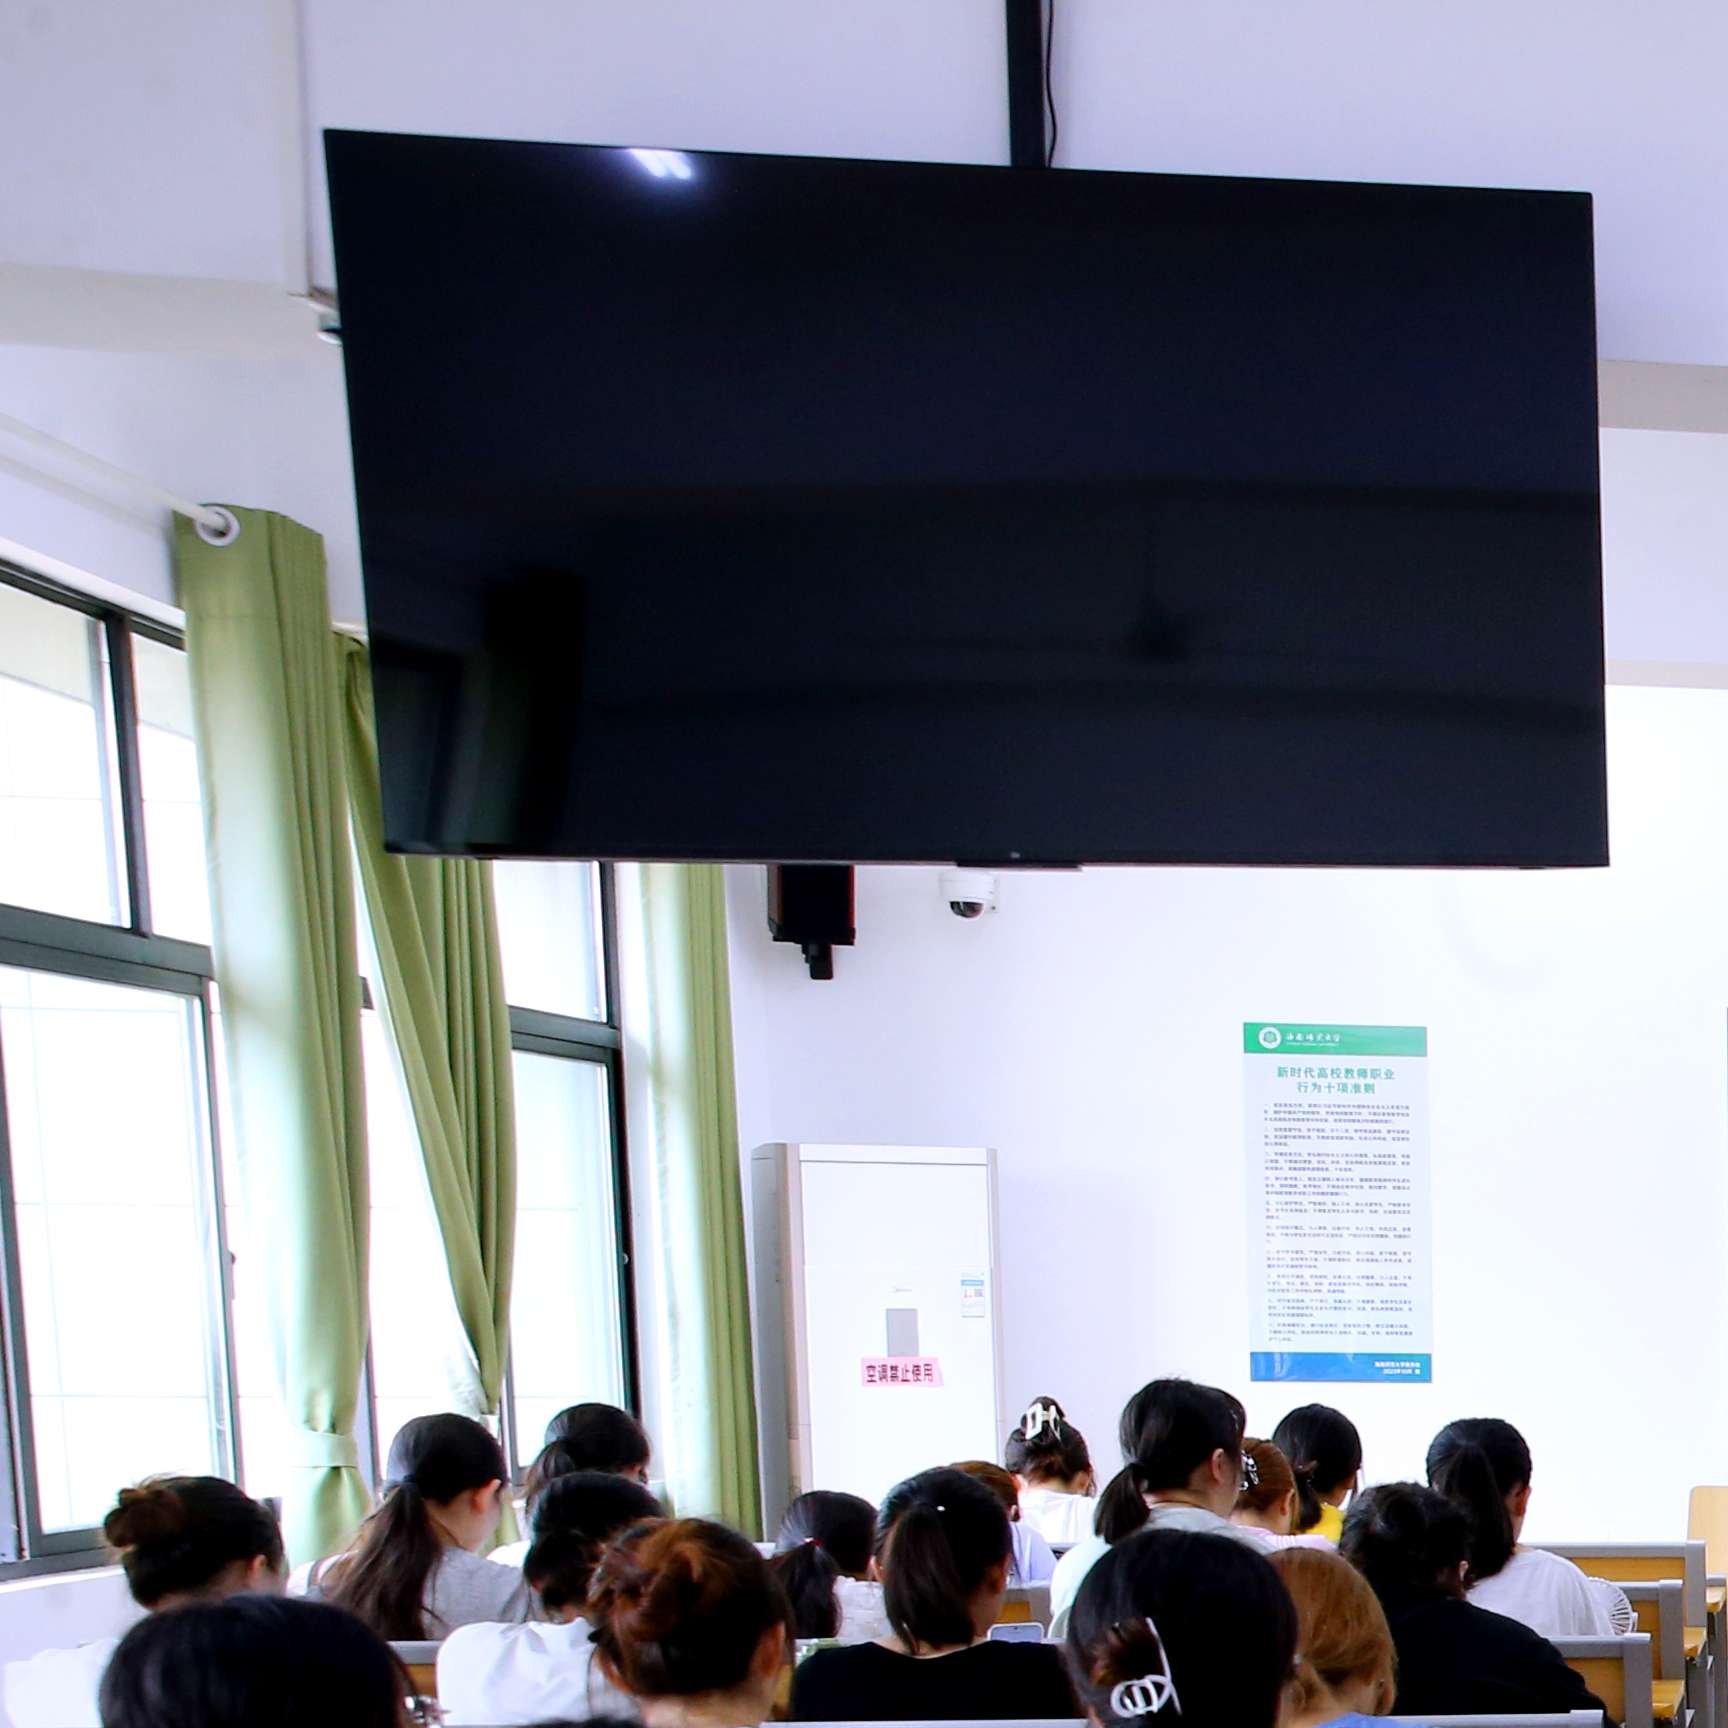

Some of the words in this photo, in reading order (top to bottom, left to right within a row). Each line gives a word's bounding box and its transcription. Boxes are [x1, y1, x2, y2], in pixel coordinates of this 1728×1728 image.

[1277, 1066, 1396, 1080] 新时代高校教师职业
[1297, 1082, 1376, 1095] 行为十项准则
[866, 1362, 933, 1383] 空调禁止使用
